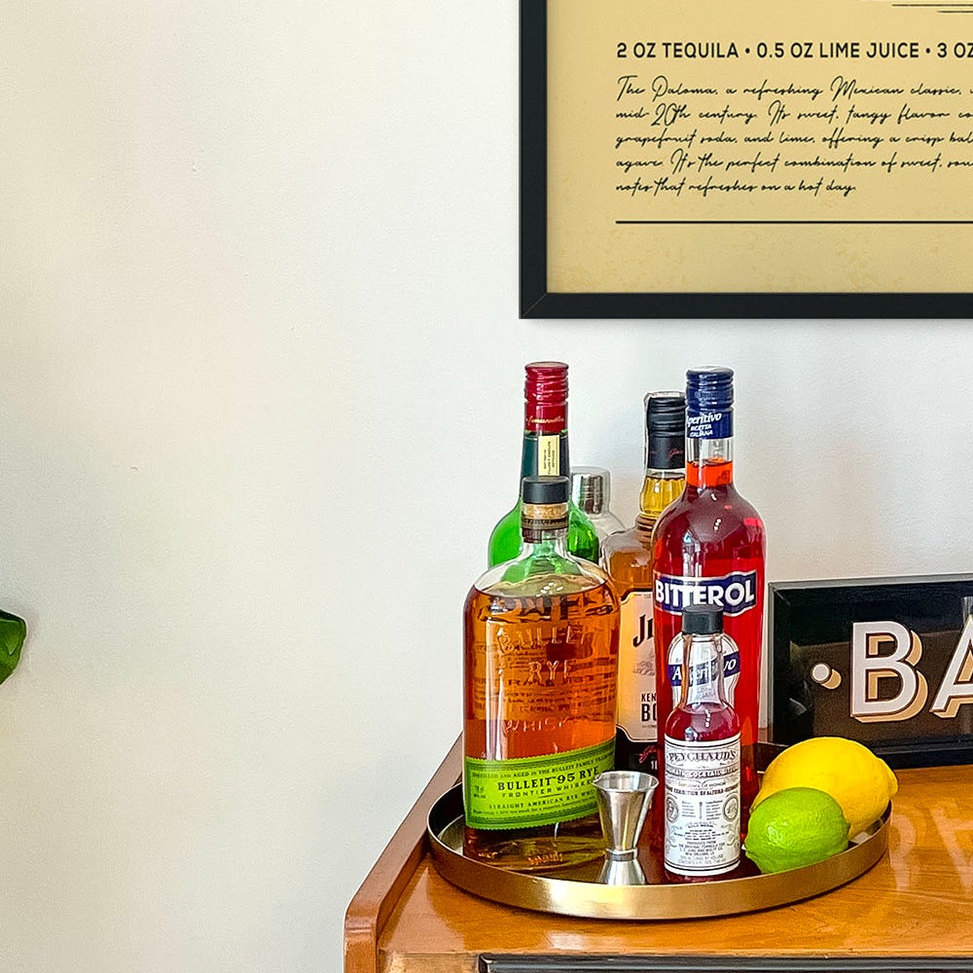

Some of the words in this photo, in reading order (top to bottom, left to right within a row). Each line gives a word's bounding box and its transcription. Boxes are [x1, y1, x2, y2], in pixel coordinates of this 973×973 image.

[616, 42, 627, 59] 2
[633, 42, 657, 59] OZ
[661, 42, 739, 59] TEQUILA
[756, 42, 785, 59] 0.5
[790, 42, 814, 59] OZ
[819, 42, 860, 59] LIME
[866, 42, 919, 59] JUICE
[937, 42, 948, 59] 3
[616, 74, 646, 102] The
[743, 130, 775, 143] and
[697, 152, 724, 173] the
[880, 151, 898, 173] of
[798, 176, 824, 197] hot
[655, 578, 755, 609] BITTEROL
[556, 772, 576, 784] 95
[579, 766, 599, 779] RYE
[502, 788, 552, 798] FRONTIER
[557, 779, 593, 793] WHISKE
[527, 796, 564, 807] AMERICAN
